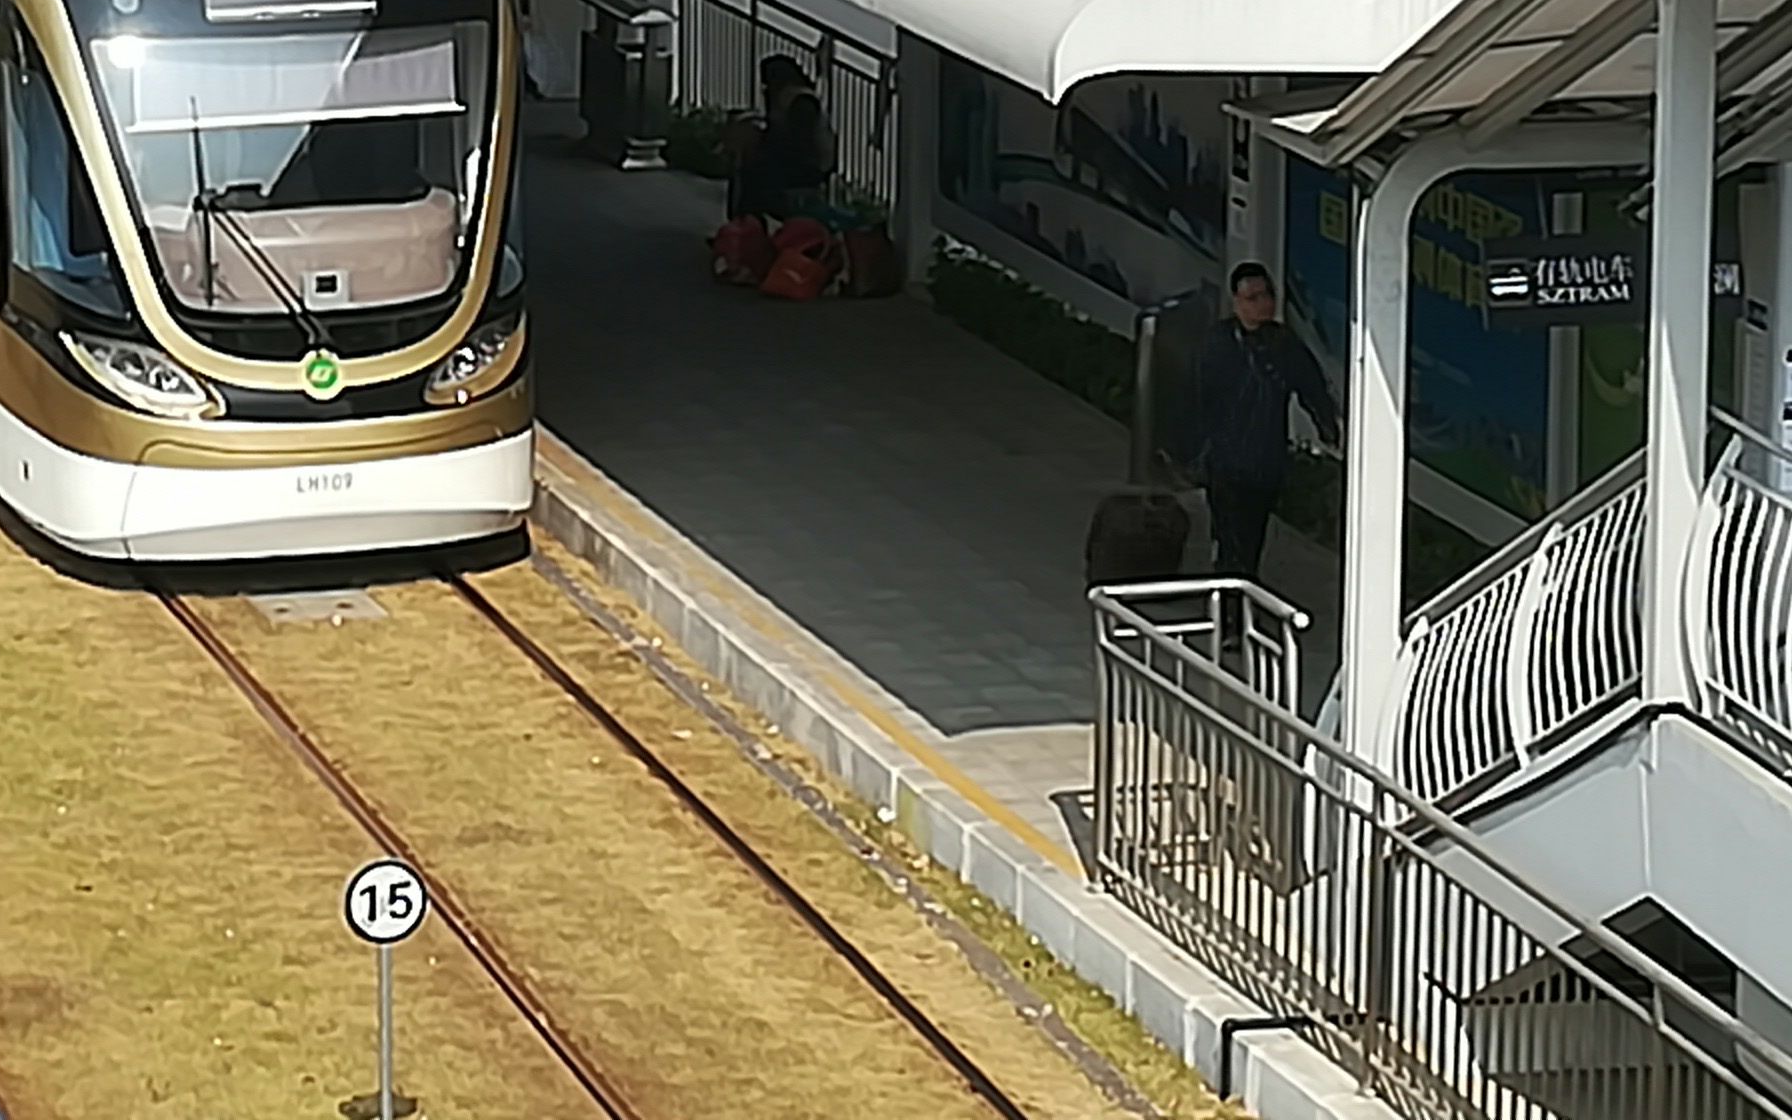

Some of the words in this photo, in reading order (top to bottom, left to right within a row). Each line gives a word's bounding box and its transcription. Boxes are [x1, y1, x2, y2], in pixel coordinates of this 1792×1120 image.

[1536, 283, 1631, 305] SZTRAM
[296, 471, 353, 494] LH109
[359, 880, 413, 922] 15
